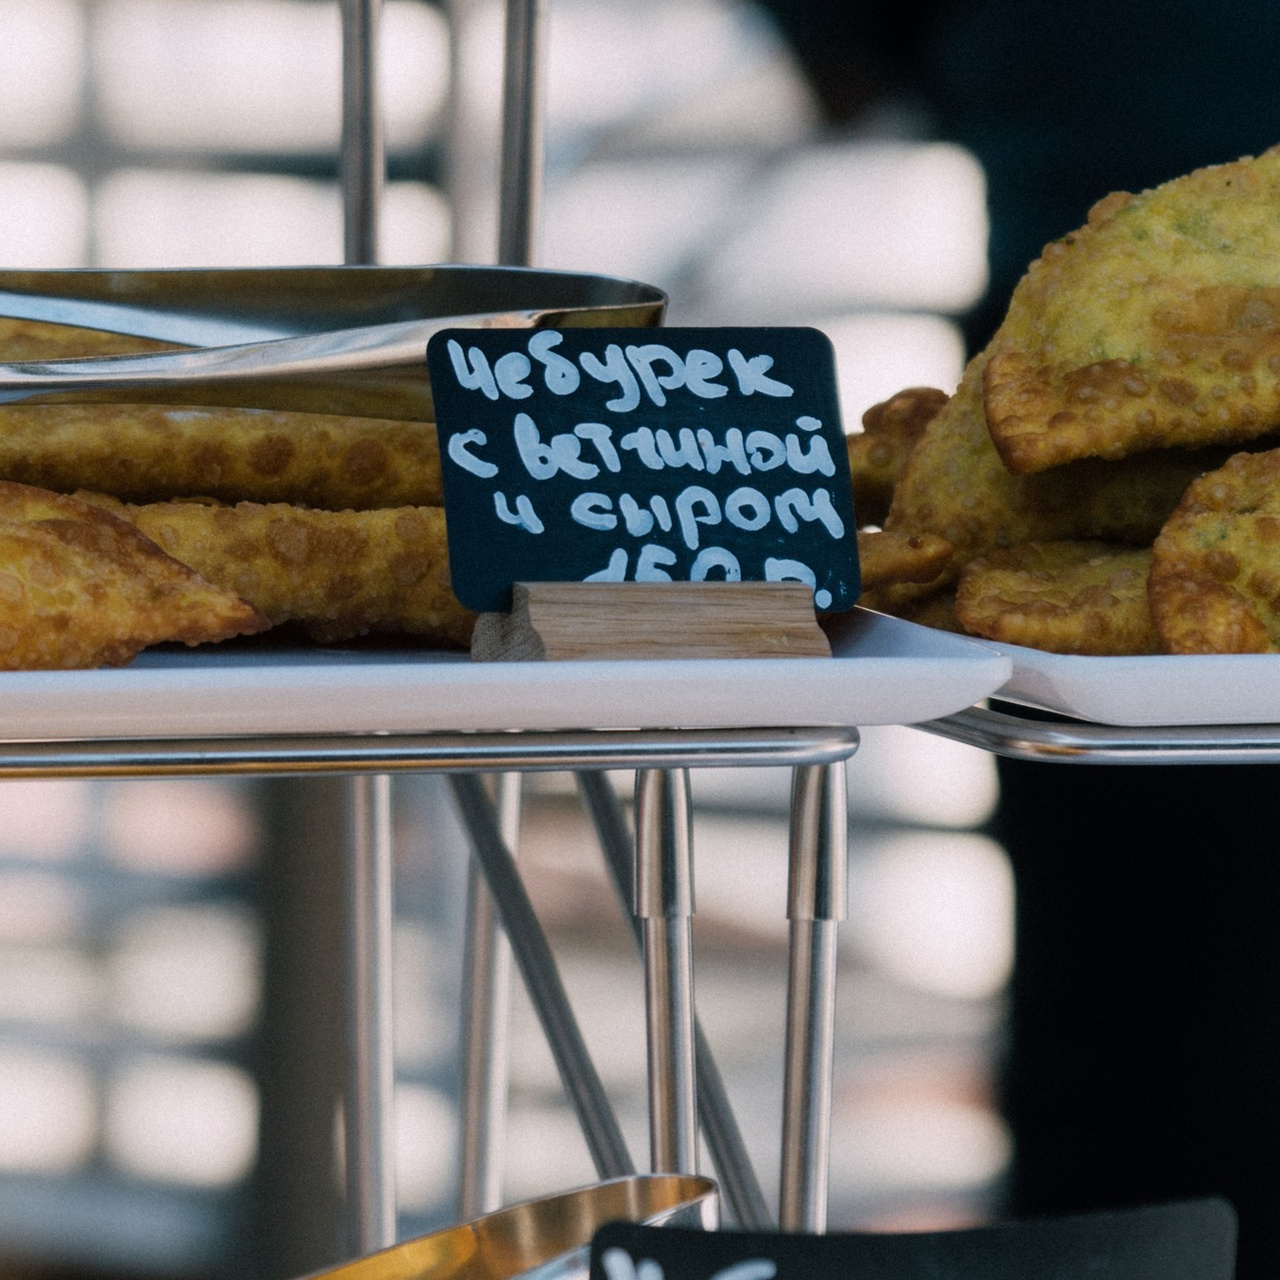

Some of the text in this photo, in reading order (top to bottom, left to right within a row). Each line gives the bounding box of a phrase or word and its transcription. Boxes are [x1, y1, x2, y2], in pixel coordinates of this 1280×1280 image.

[447, 330, 794, 412] Чебурек
[449, 412, 836, 480] с ветчиной
[494, 485, 845, 550] и сыром
